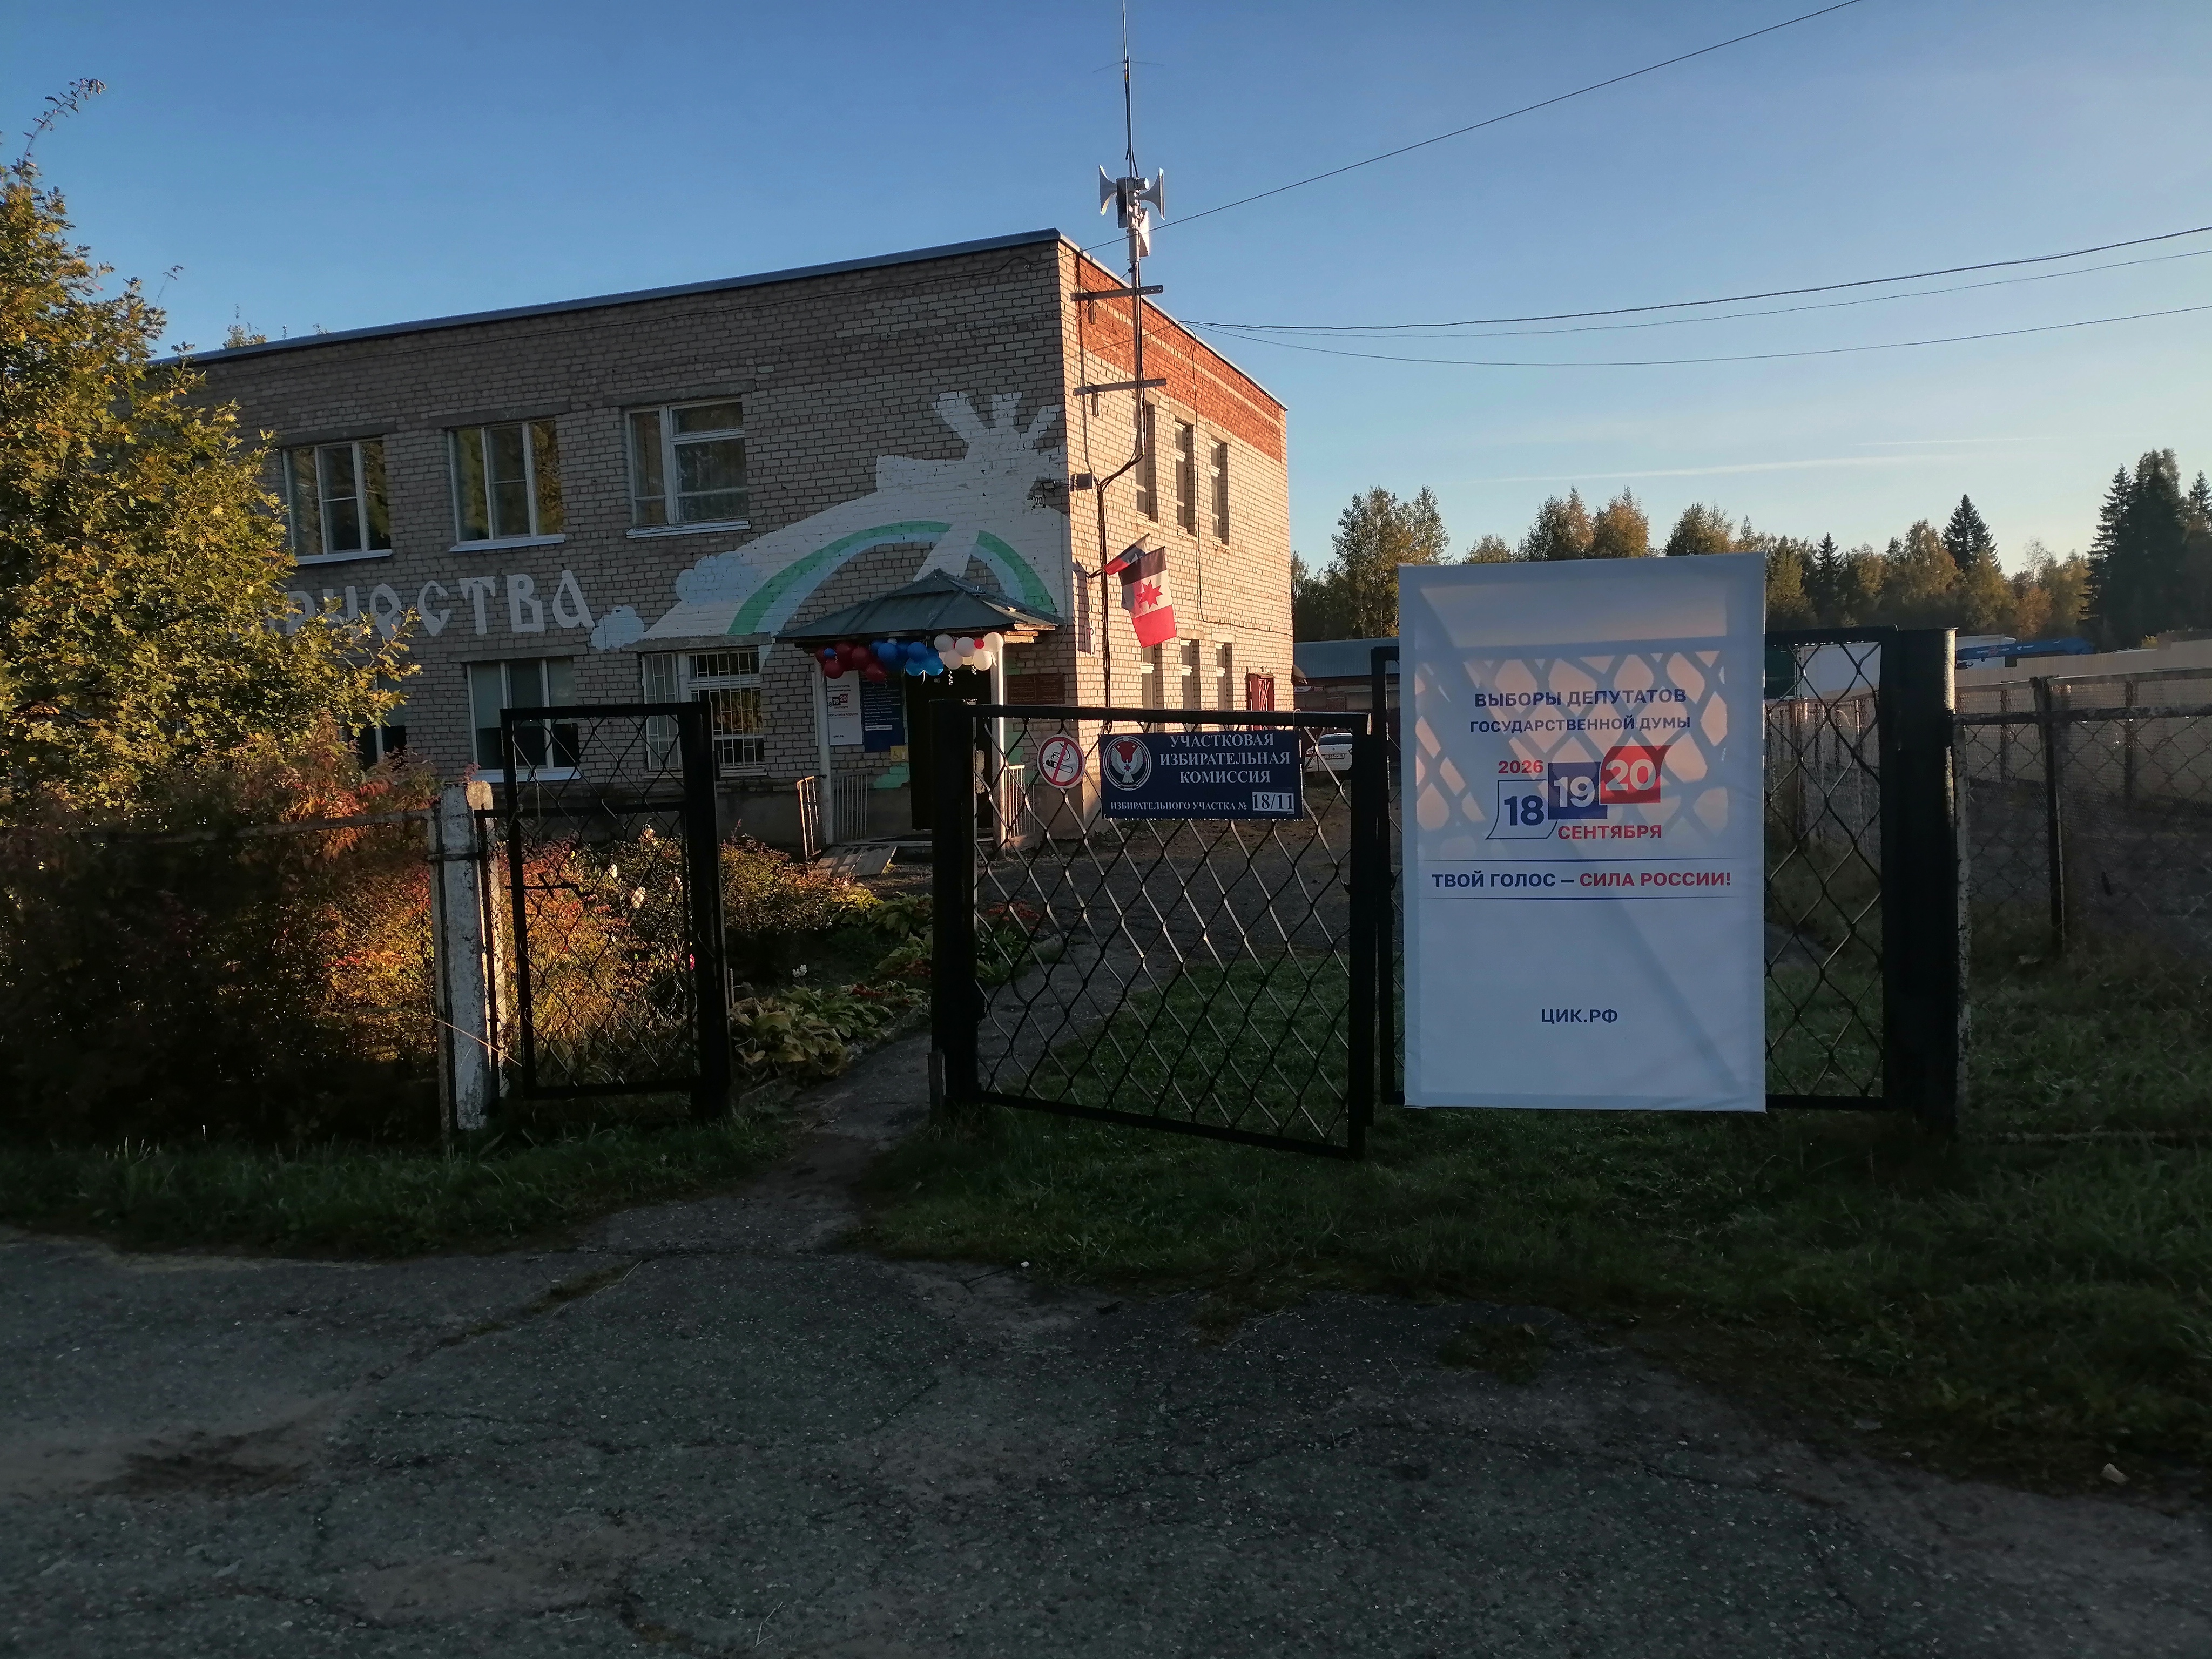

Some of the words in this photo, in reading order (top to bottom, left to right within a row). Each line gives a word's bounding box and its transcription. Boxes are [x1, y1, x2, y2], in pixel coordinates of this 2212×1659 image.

[1035, 497, 1043, 505] 20
[262, 569, 595, 639] РЧЕСТВА
[1475, 691, 1561, 707] ВЫБОРЫ
[1567, 689, 1687, 707] ДЕПУТАТОВ
[1471, 714, 1635, 734] ГОСУДАРСТВЕННОЙ
[1638, 717, 1691, 731] ДУМЫ
[1170, 733, 1274, 748] УЧАСТКОВАЯ
[1159, 751, 1291, 766] ИЗБИРАТЕЛЬНАЯ
[1498, 760, 1544, 774] 2026
[1180, 770, 1271, 784] КОМИССИЯ
[1503, 795, 1545, 826] 18
[1554, 776, 1595, 808] 19
[1605, 759, 1656, 791] 20
[1110, 801, 1190, 811] ИЗБИРАТЕЛЬНОГО
[1192, 801, 1236, 811] УЧАСТКА
[1237, 801, 1247, 810] №
[1252, 793, 1294, 811] 18/11
[1557, 824, 1662, 840] СЕНТЯБРЯ
[1431, 869, 1485, 888] ТВОЙ
[1490, 873, 1556, 887] ГОЛОС
[1580, 872, 1635, 887] СИЛА
[1641, 872, 1731, 887] РОССИИ!
[1541, 1008, 1618, 1025] ЦИК.РФ
